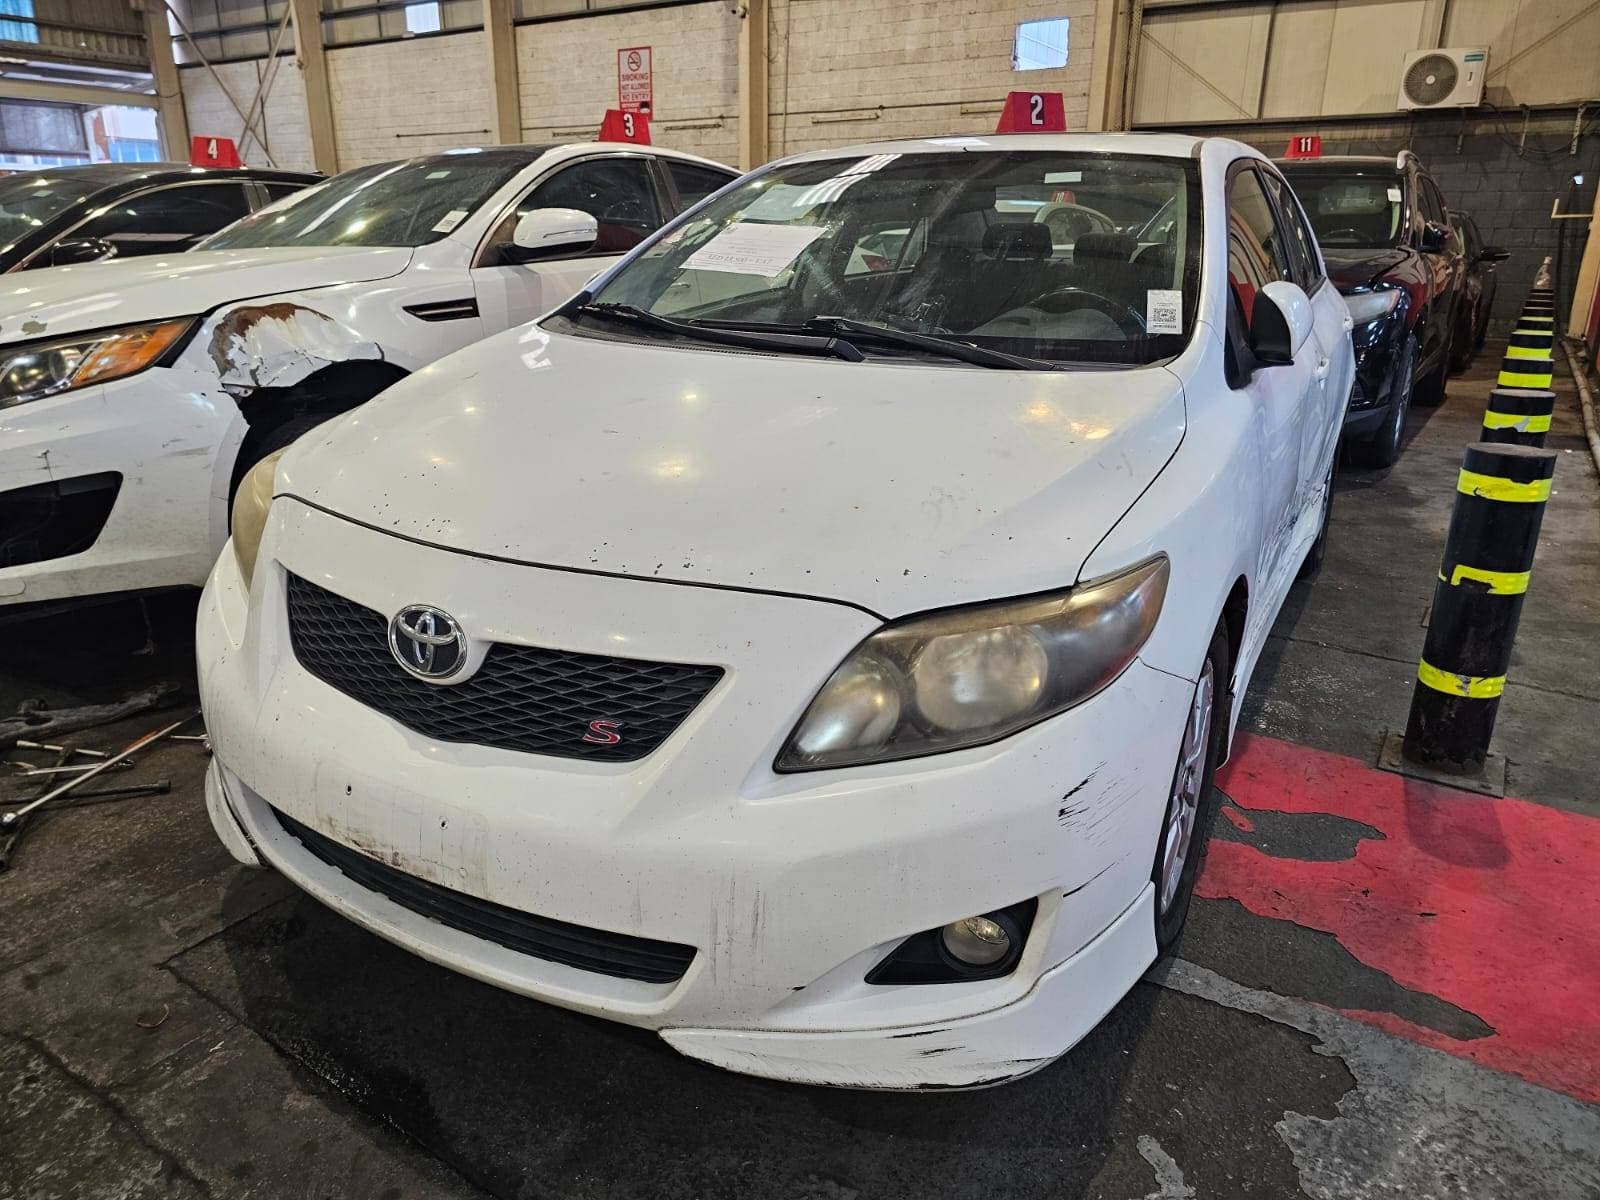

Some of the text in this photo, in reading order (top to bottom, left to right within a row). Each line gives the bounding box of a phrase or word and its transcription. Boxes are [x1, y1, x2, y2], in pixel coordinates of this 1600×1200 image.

[622, 73, 648, 81] SMOKING
[632, 93, 648, 101] ENTRY
[1030, 94, 1044, 125] 2
[624, 113, 635, 137] 3
[207, 139, 218, 160] 4
[1300, 137, 1312, 152] 11
[582, 720, 622, 744] S
